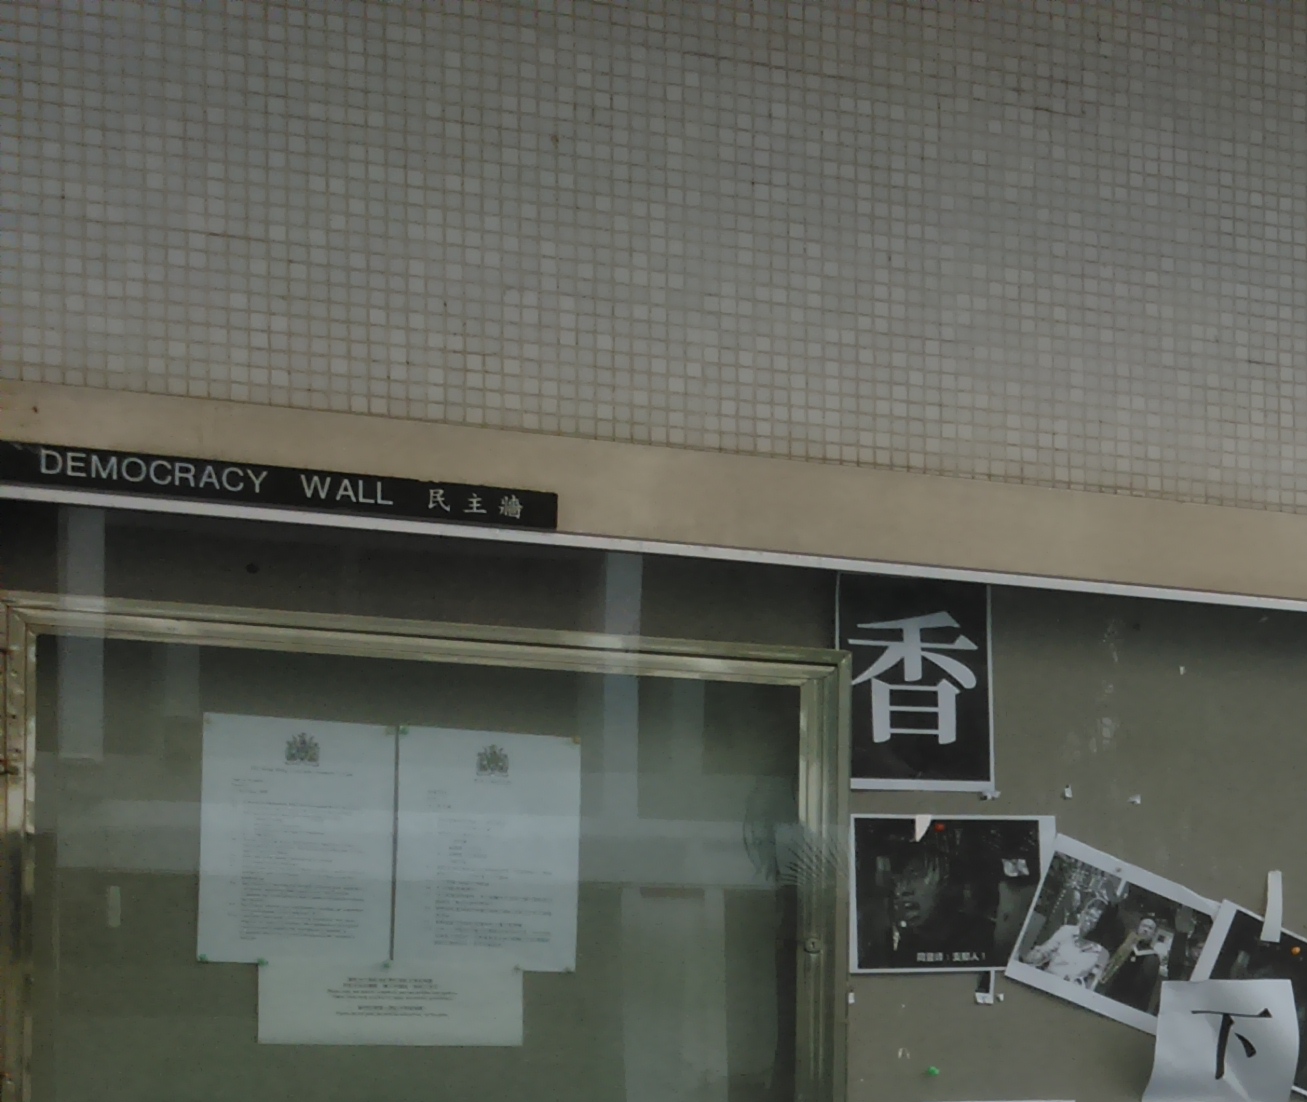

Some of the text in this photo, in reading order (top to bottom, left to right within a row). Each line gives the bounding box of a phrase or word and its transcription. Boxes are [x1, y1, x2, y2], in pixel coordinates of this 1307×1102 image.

[39, 449, 268, 494] DEMOCRACY
[301, 474, 394, 506] WALL
[848, 610, 978, 744] 香
